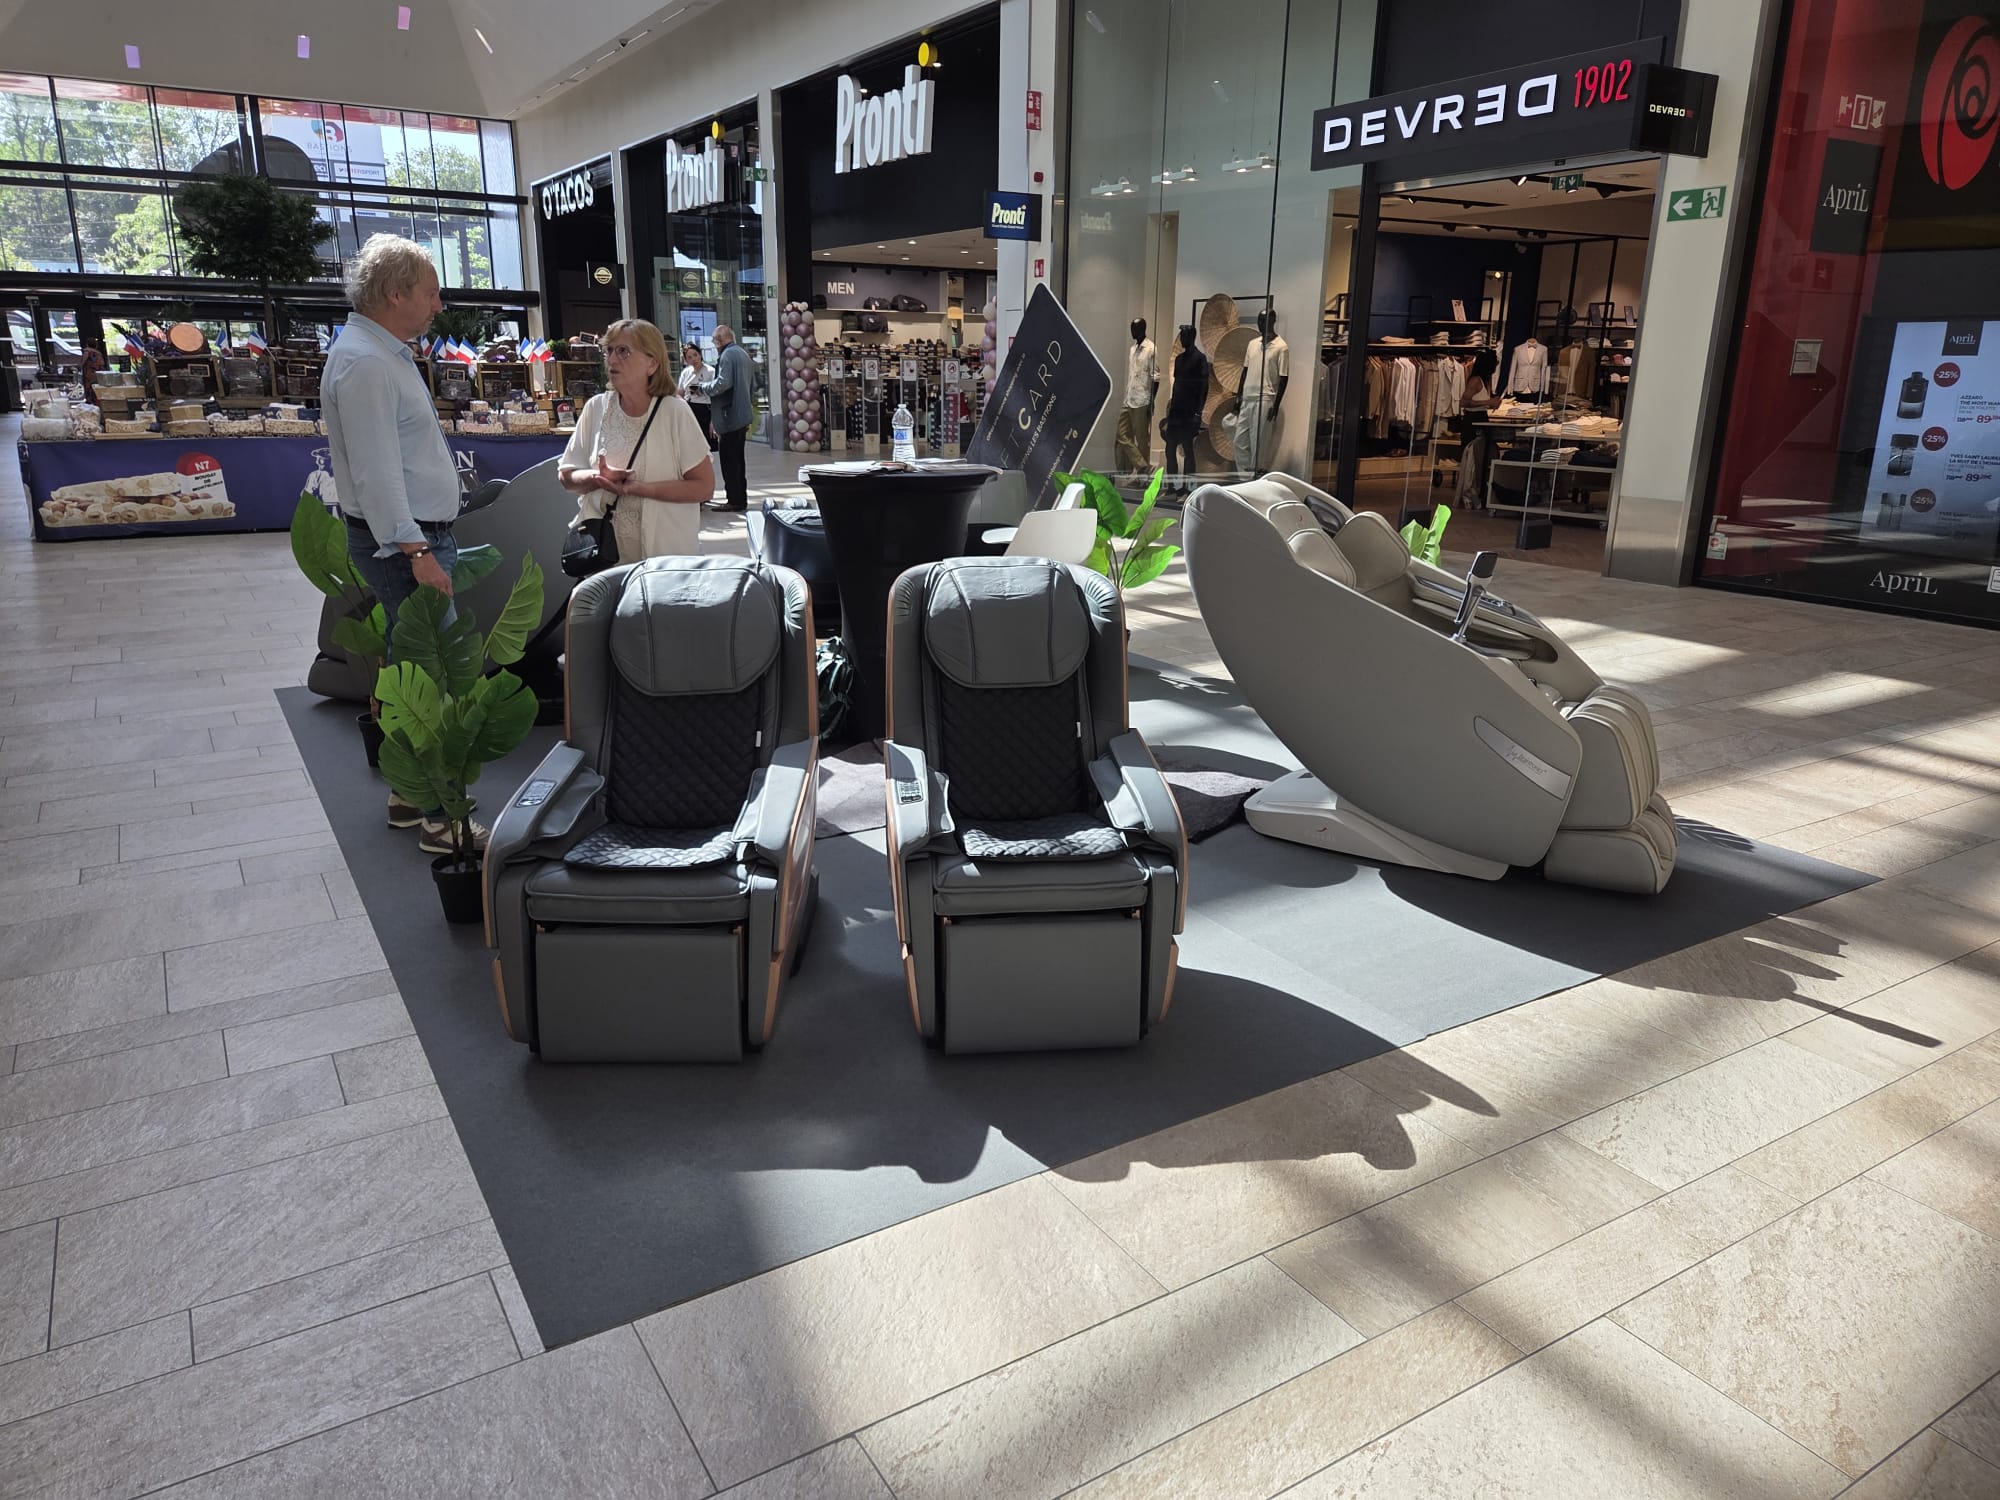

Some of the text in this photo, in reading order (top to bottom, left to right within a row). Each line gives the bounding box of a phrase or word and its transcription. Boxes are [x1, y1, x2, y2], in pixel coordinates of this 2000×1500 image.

[835, 42, 936, 174] Pronti
[1323, 58, 1632, 153] DEVRED 1902
[1649, 104, 1686, 117] DEVRED
[666, 120, 725, 214] Pronti
[991, 202, 1027, 225] Pronti
[827, 282, 855, 295] MEN
[1935, 370, 1959, 379] -25%
[1923, 435, 1946, 443] -25%
[194, 460, 210, 471] N7
